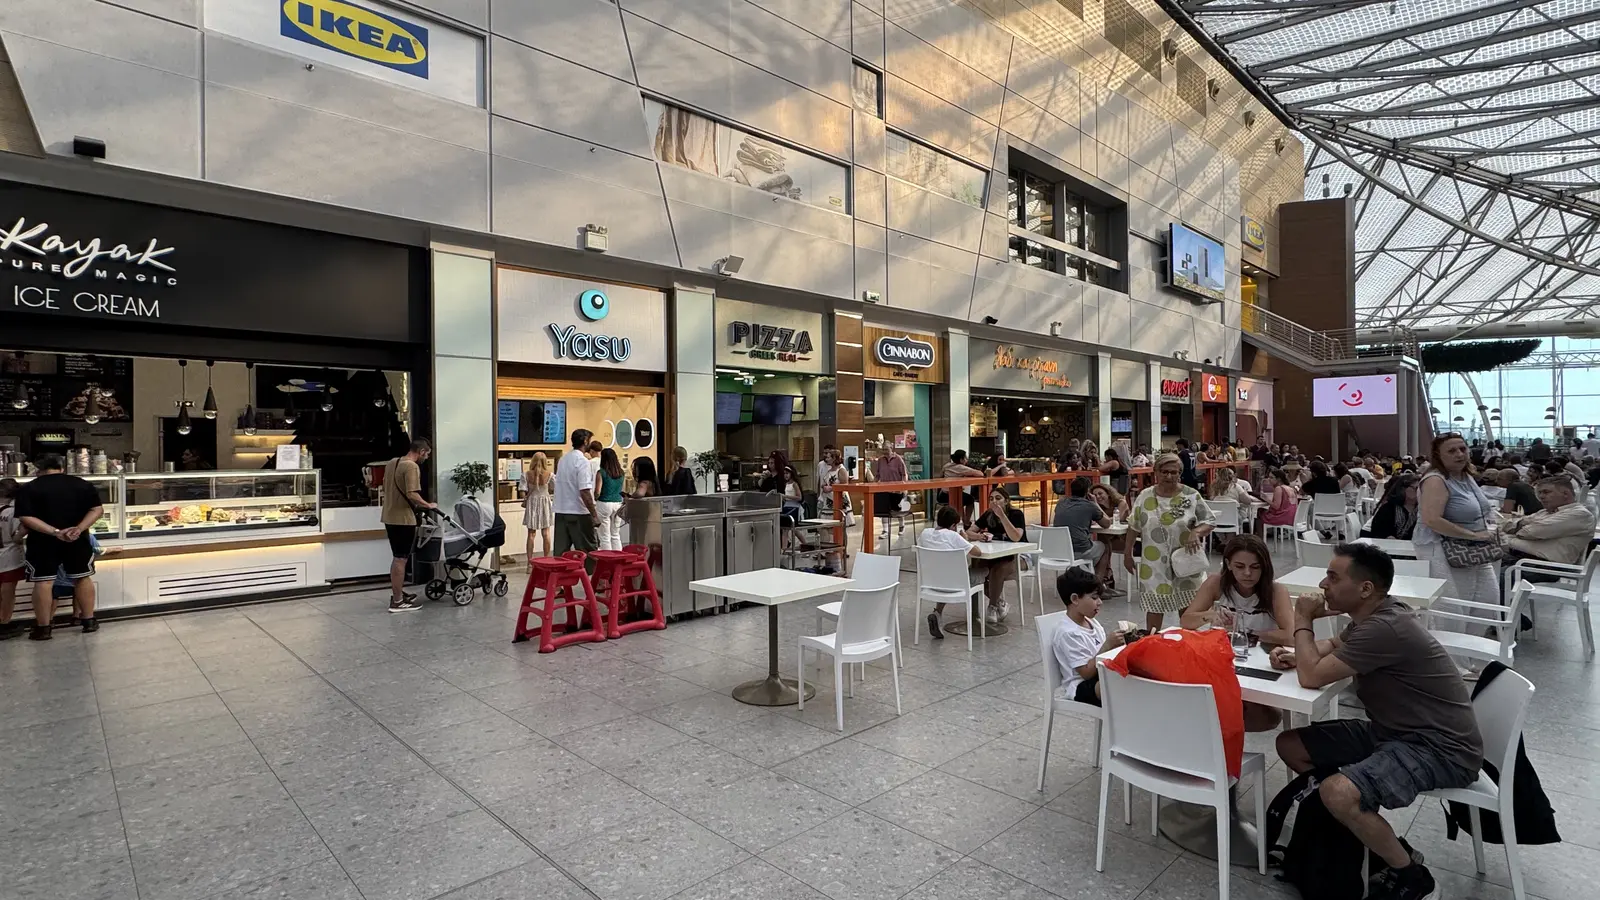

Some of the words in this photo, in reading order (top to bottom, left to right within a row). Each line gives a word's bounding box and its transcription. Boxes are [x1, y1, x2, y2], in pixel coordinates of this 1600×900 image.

[298, 2, 417, 59] IKEA
[0, 217, 177, 277] Kayak
[0, 259, 61, 272] URE
[95, 269, 177, 286] MAGIC
[14, 285, 60, 310] ICE
[73, 292, 160, 318] CREAM
[549, 322, 631, 362] Yasu
[731, 321, 813, 353] PIZZA
[883, 342, 930, 361] CINNABON
